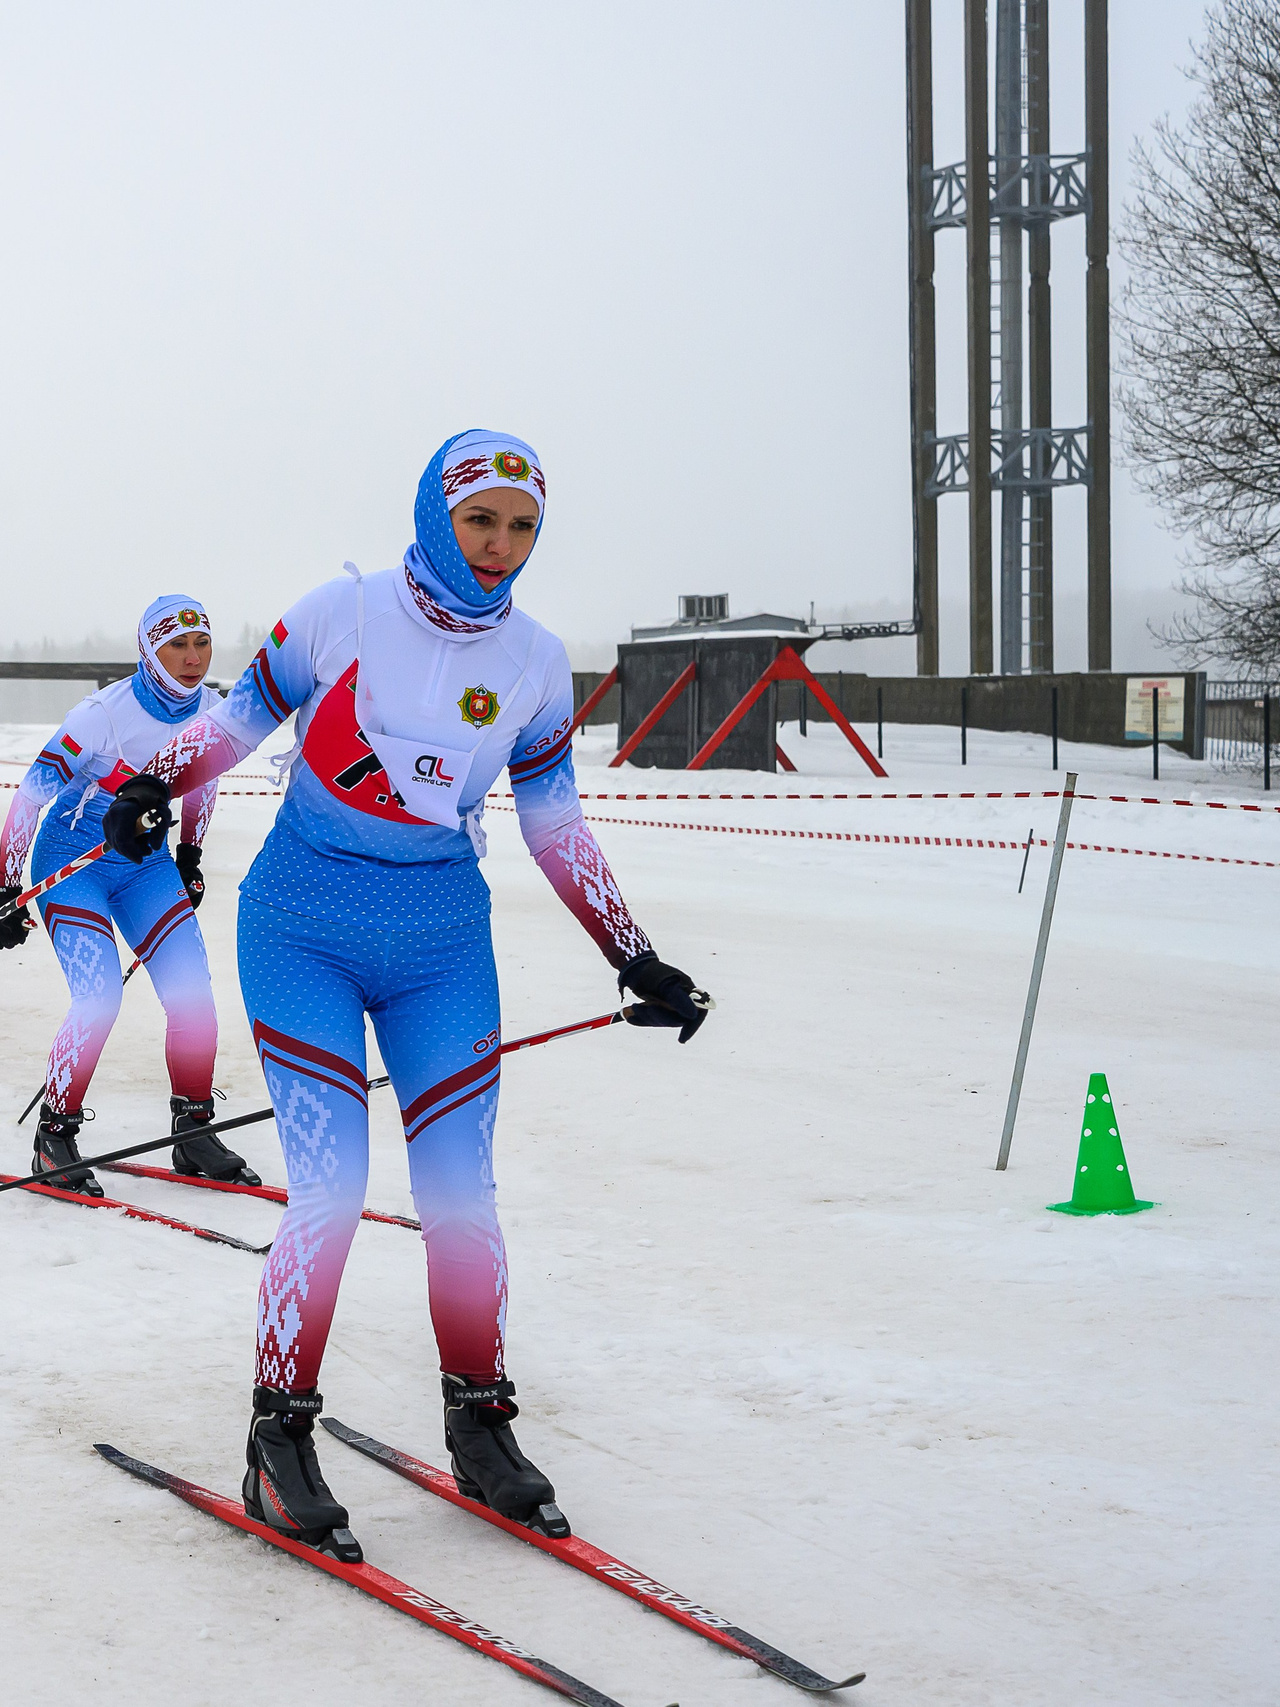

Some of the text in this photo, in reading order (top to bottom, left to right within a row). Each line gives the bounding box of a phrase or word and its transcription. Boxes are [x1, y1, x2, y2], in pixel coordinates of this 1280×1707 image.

[524, 716, 570, 756] ORAZ
[472, 1023, 500, 1054] OR
[289, 1400, 322, 1408] MARA
[454, 1389, 498, 1399] MARAX
